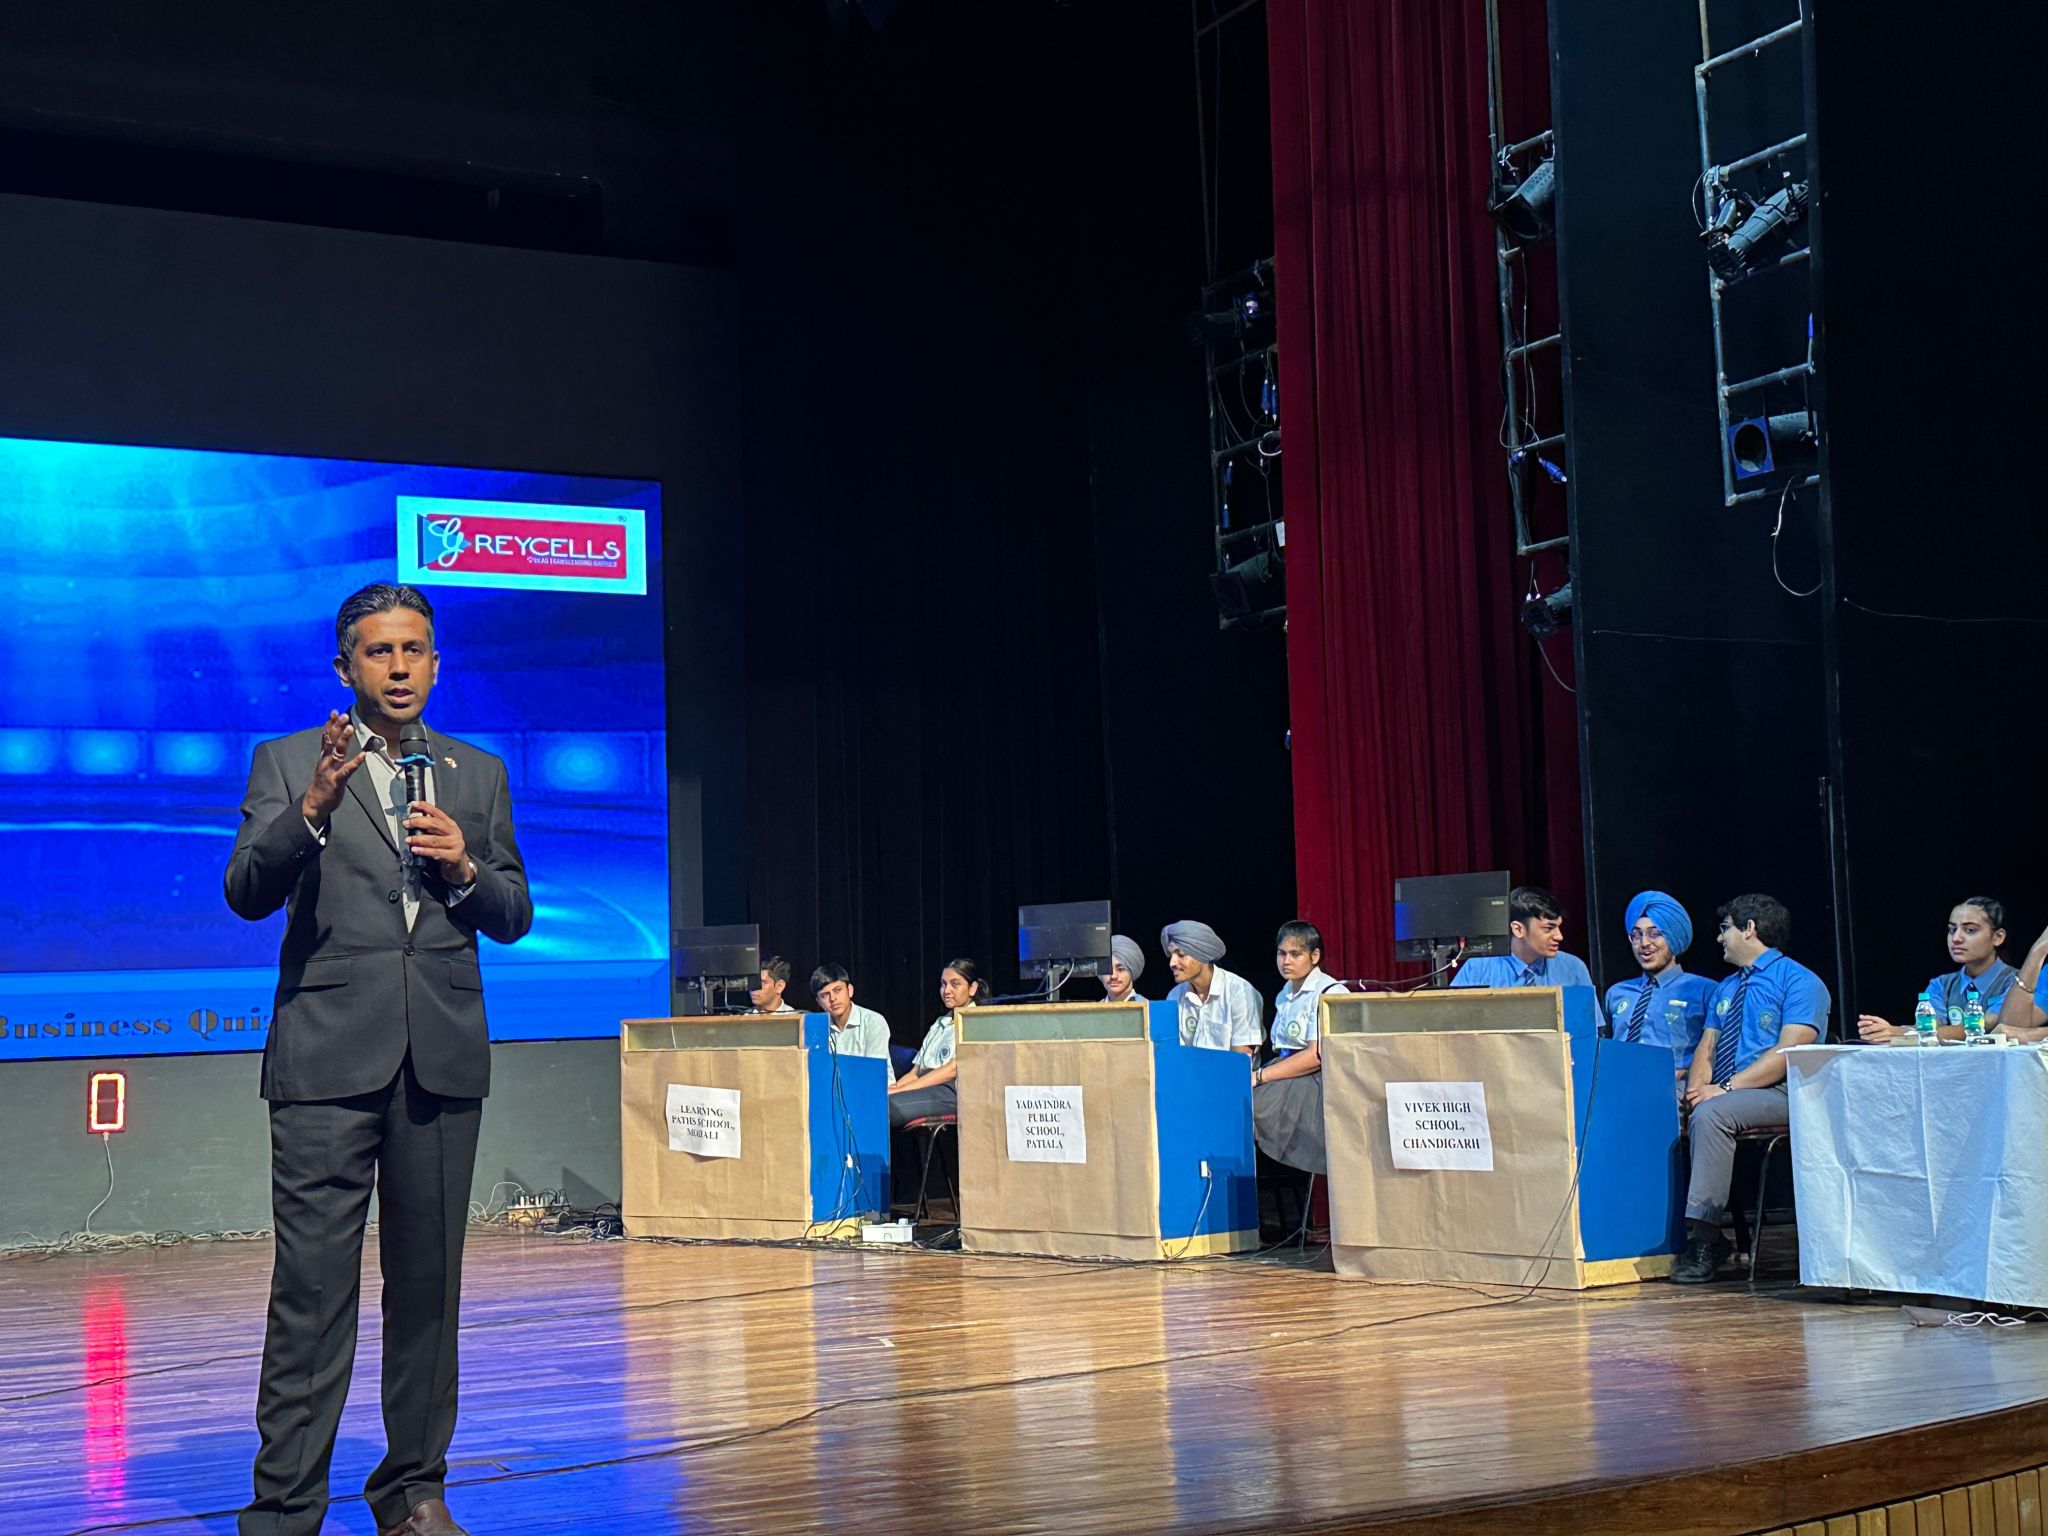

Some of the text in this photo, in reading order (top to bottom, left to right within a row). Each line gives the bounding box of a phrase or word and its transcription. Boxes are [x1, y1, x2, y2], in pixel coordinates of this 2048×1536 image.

[427, 517, 621, 567] GREYCELLS
[1016, 1099, 1072, 1110] YADAVINDRA
[1404, 1102, 1471, 1113] VIVEK HIGH
[680, 1104, 723, 1117] LEARNING
[671, 1115, 696, 1126] PATHS
[1028, 1113, 1061, 1123] PUBLIC
[1415, 1119, 1465, 1132] SCHOOL,
[1025, 1126, 1065, 1137] SCHOOL,
[1026, 1139, 1064, 1149] PATIALA
[1402, 1138, 1480, 1149] CHANDIGARH
